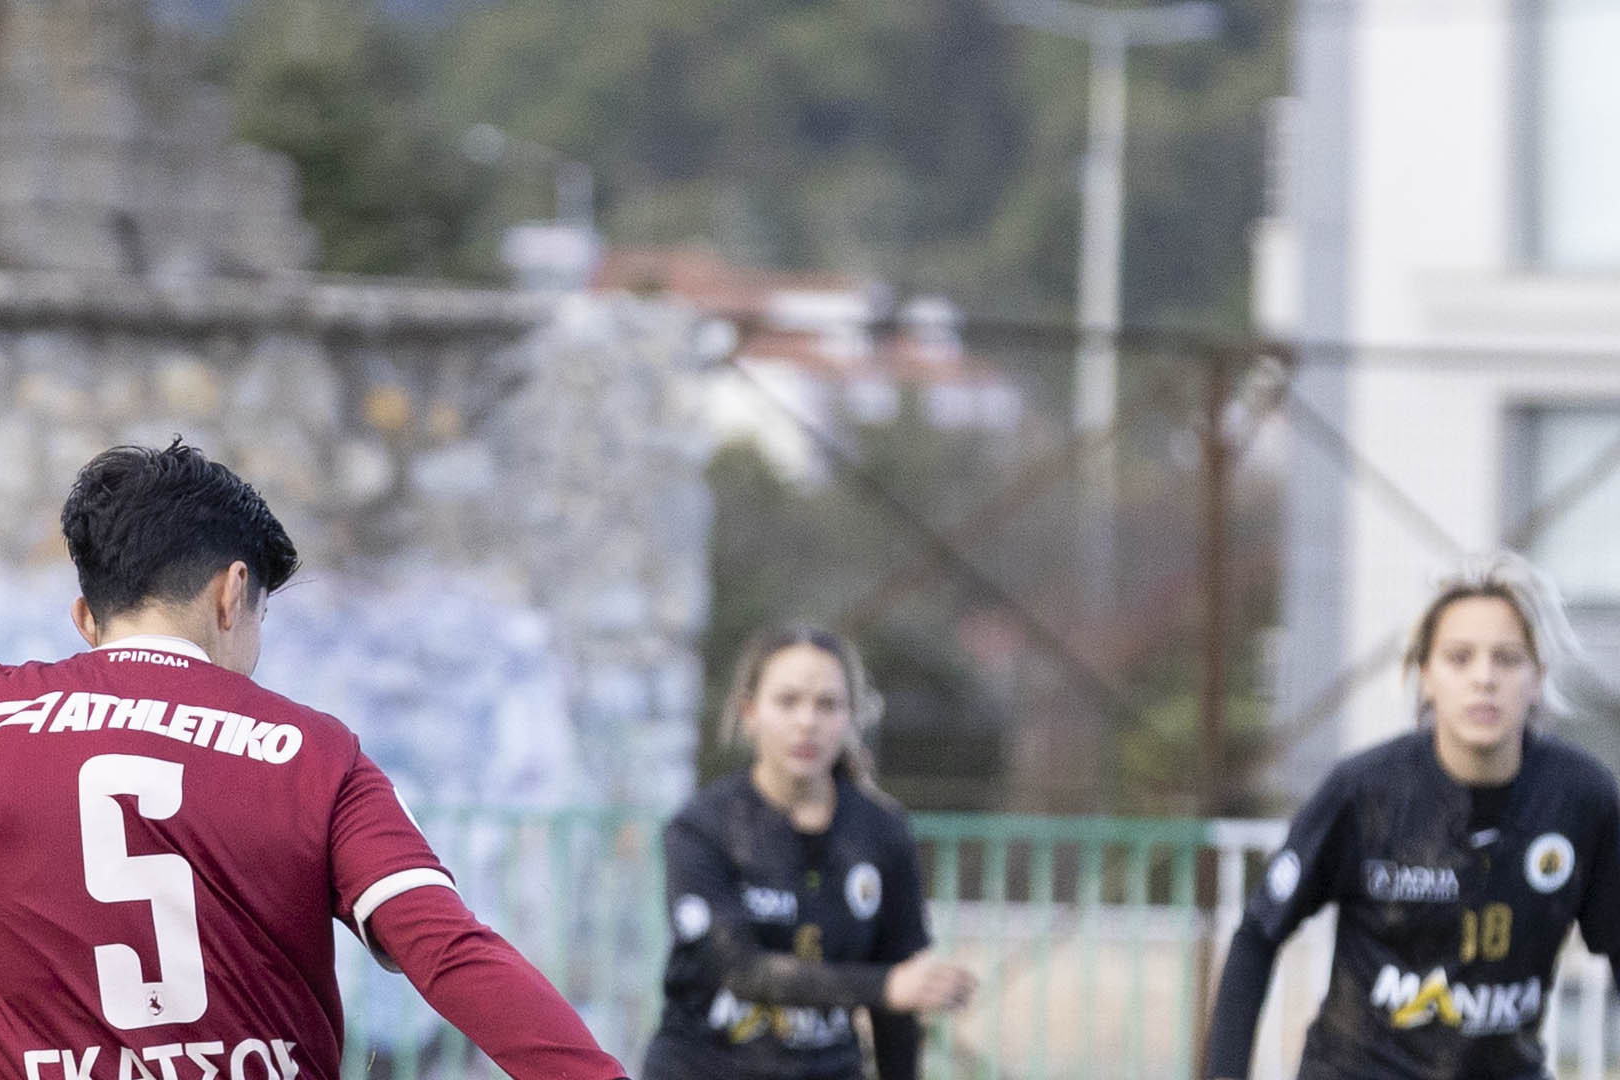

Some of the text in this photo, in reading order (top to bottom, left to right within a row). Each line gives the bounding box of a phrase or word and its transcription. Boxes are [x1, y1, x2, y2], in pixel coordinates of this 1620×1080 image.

[107, 650, 189, 669] ΤΡΙΠΟΛΗ
[48, 691, 304, 765] ATHLETIKO
[78, 753, 209, 1031] 5
